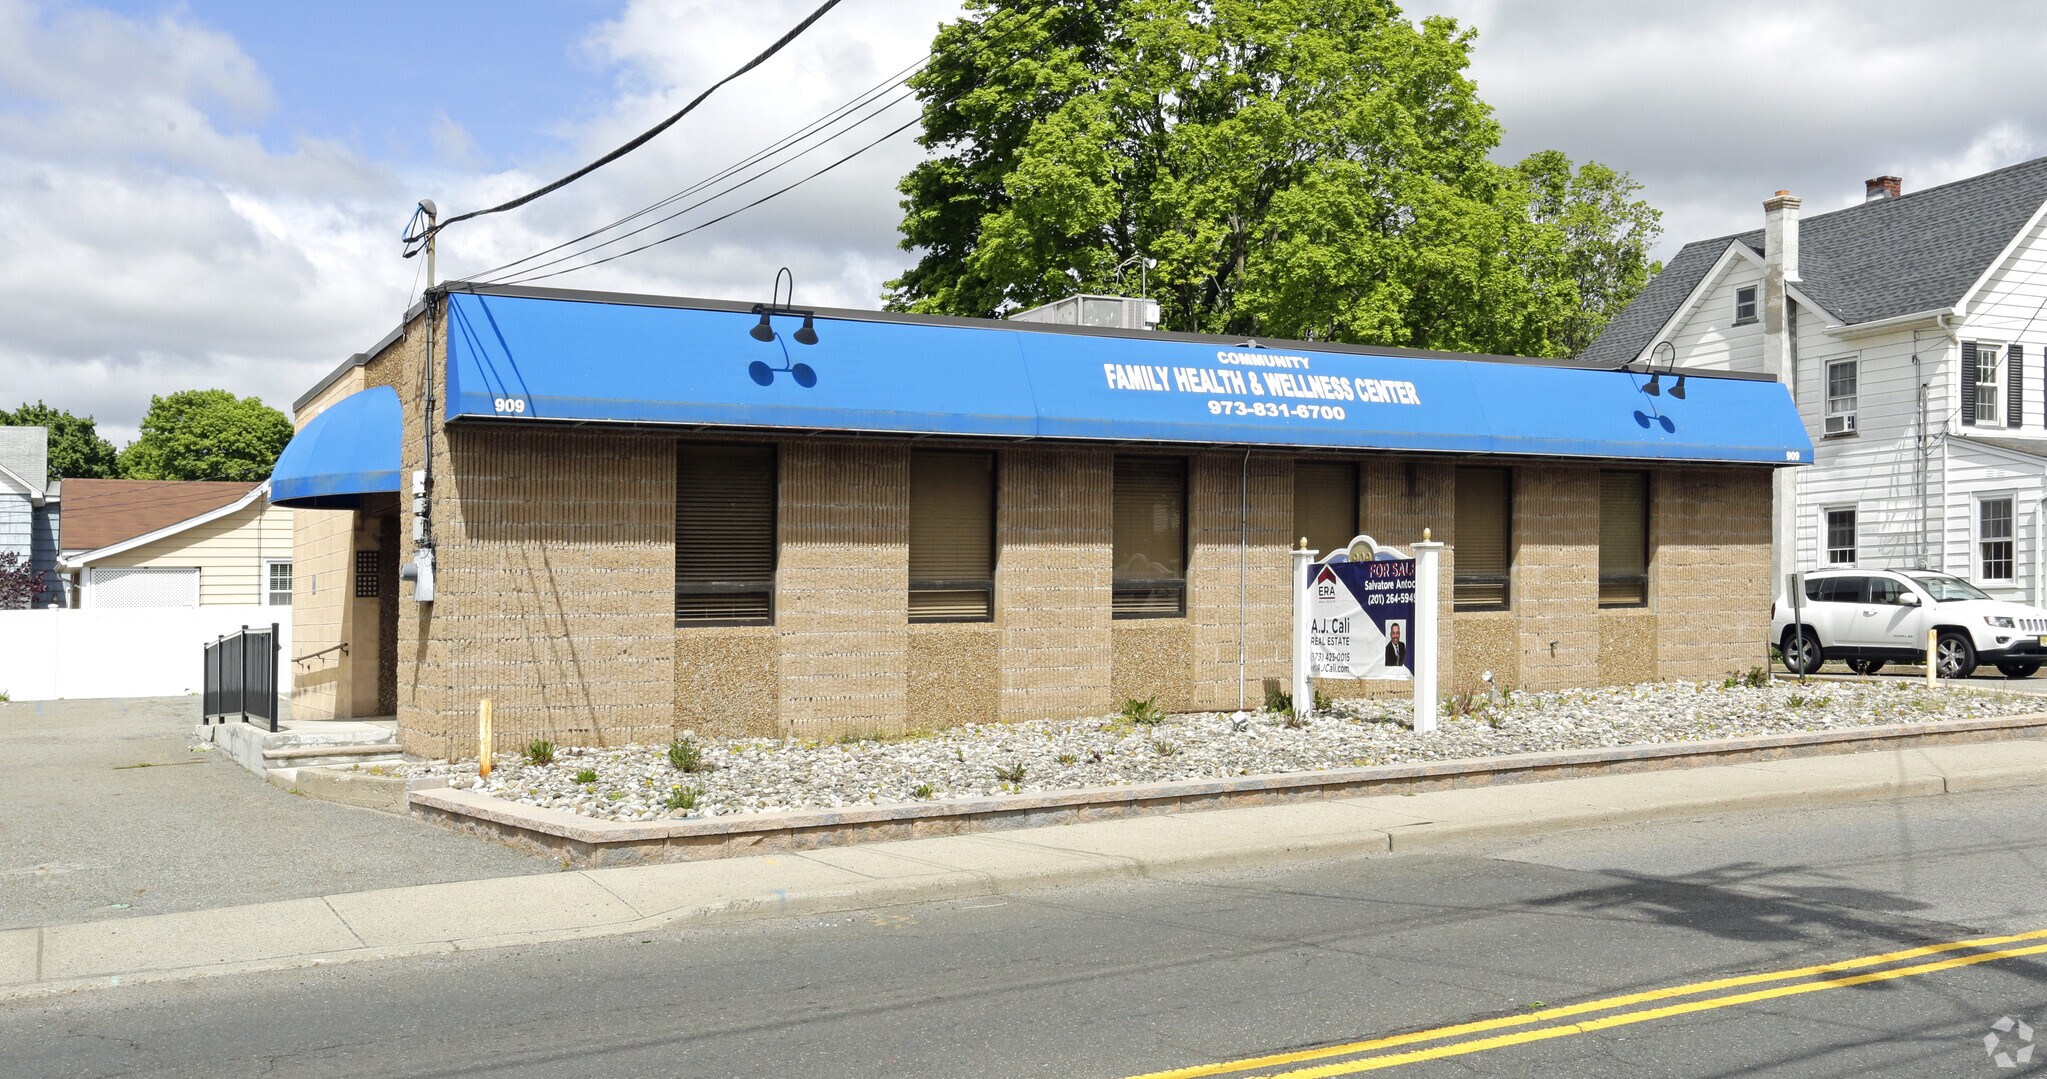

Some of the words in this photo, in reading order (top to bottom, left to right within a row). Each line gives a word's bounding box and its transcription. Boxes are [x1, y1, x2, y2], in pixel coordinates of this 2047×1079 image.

[1217, 351, 1310, 369] COMMUNITY
[1103, 363, 1169, 391] FAMILY
[1173, 367, 1247, 395] HEALTH
[1249, 371, 1265, 396] &
[1263, 372, 1354, 401] WELLNESS
[1354, 378, 1421, 405] CENTER
[494, 397, 525, 413] 909
[1207, 400, 1346, 420] 973-831-6700
[1786, 451, 1800, 461] 909
[1369, 563, 1390, 578] FOR
[1318, 586, 1336, 596] ERA
[1364, 580, 1394, 591] Salvatore
[1367, 594, 1385, 605] (201)
[1311, 618, 1329, 634] A.J.
[1331, 617, 1350, 634] Cali
[1311, 636, 1326, 646] REAL
[1327, 636, 1350, 646] ESTATE
